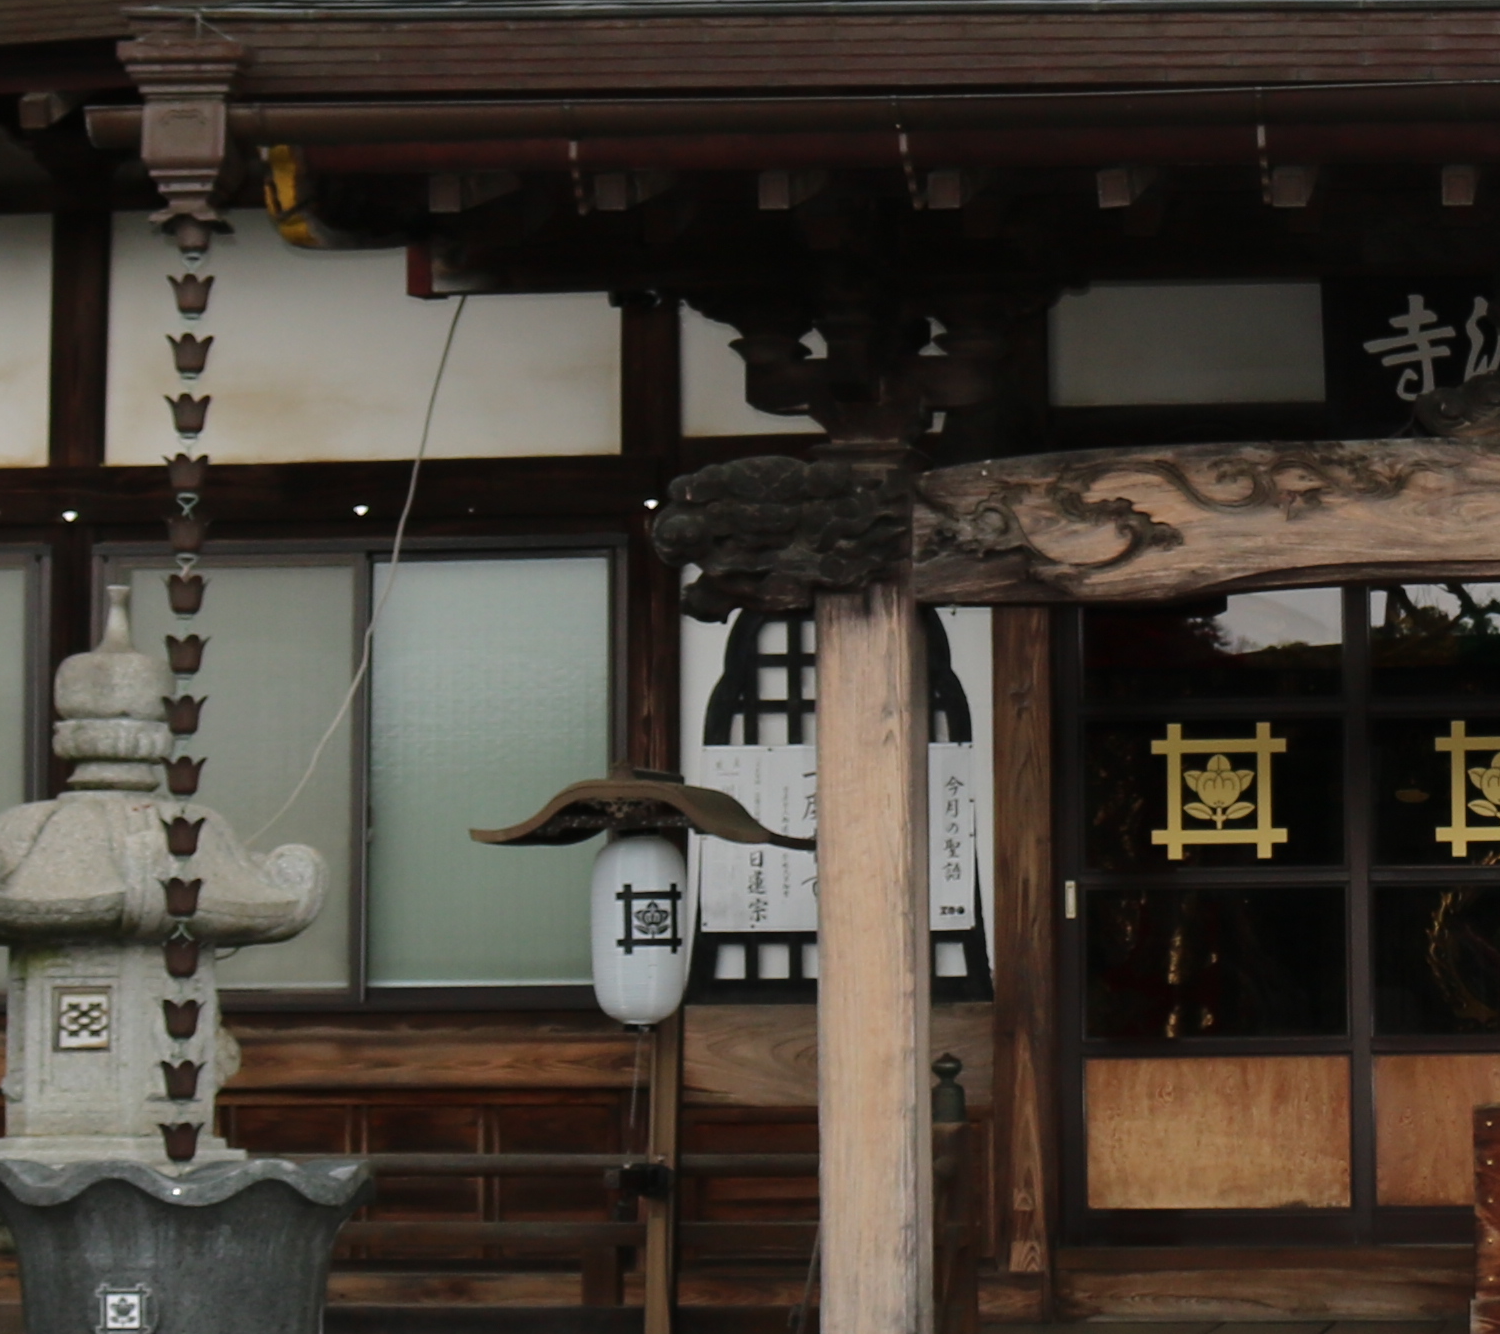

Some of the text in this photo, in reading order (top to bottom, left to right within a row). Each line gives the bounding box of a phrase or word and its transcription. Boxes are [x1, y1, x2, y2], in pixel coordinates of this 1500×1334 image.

[944, 775, 964, 881] 今月の聖語
[749, 850, 768, 922] 日蓮宗
